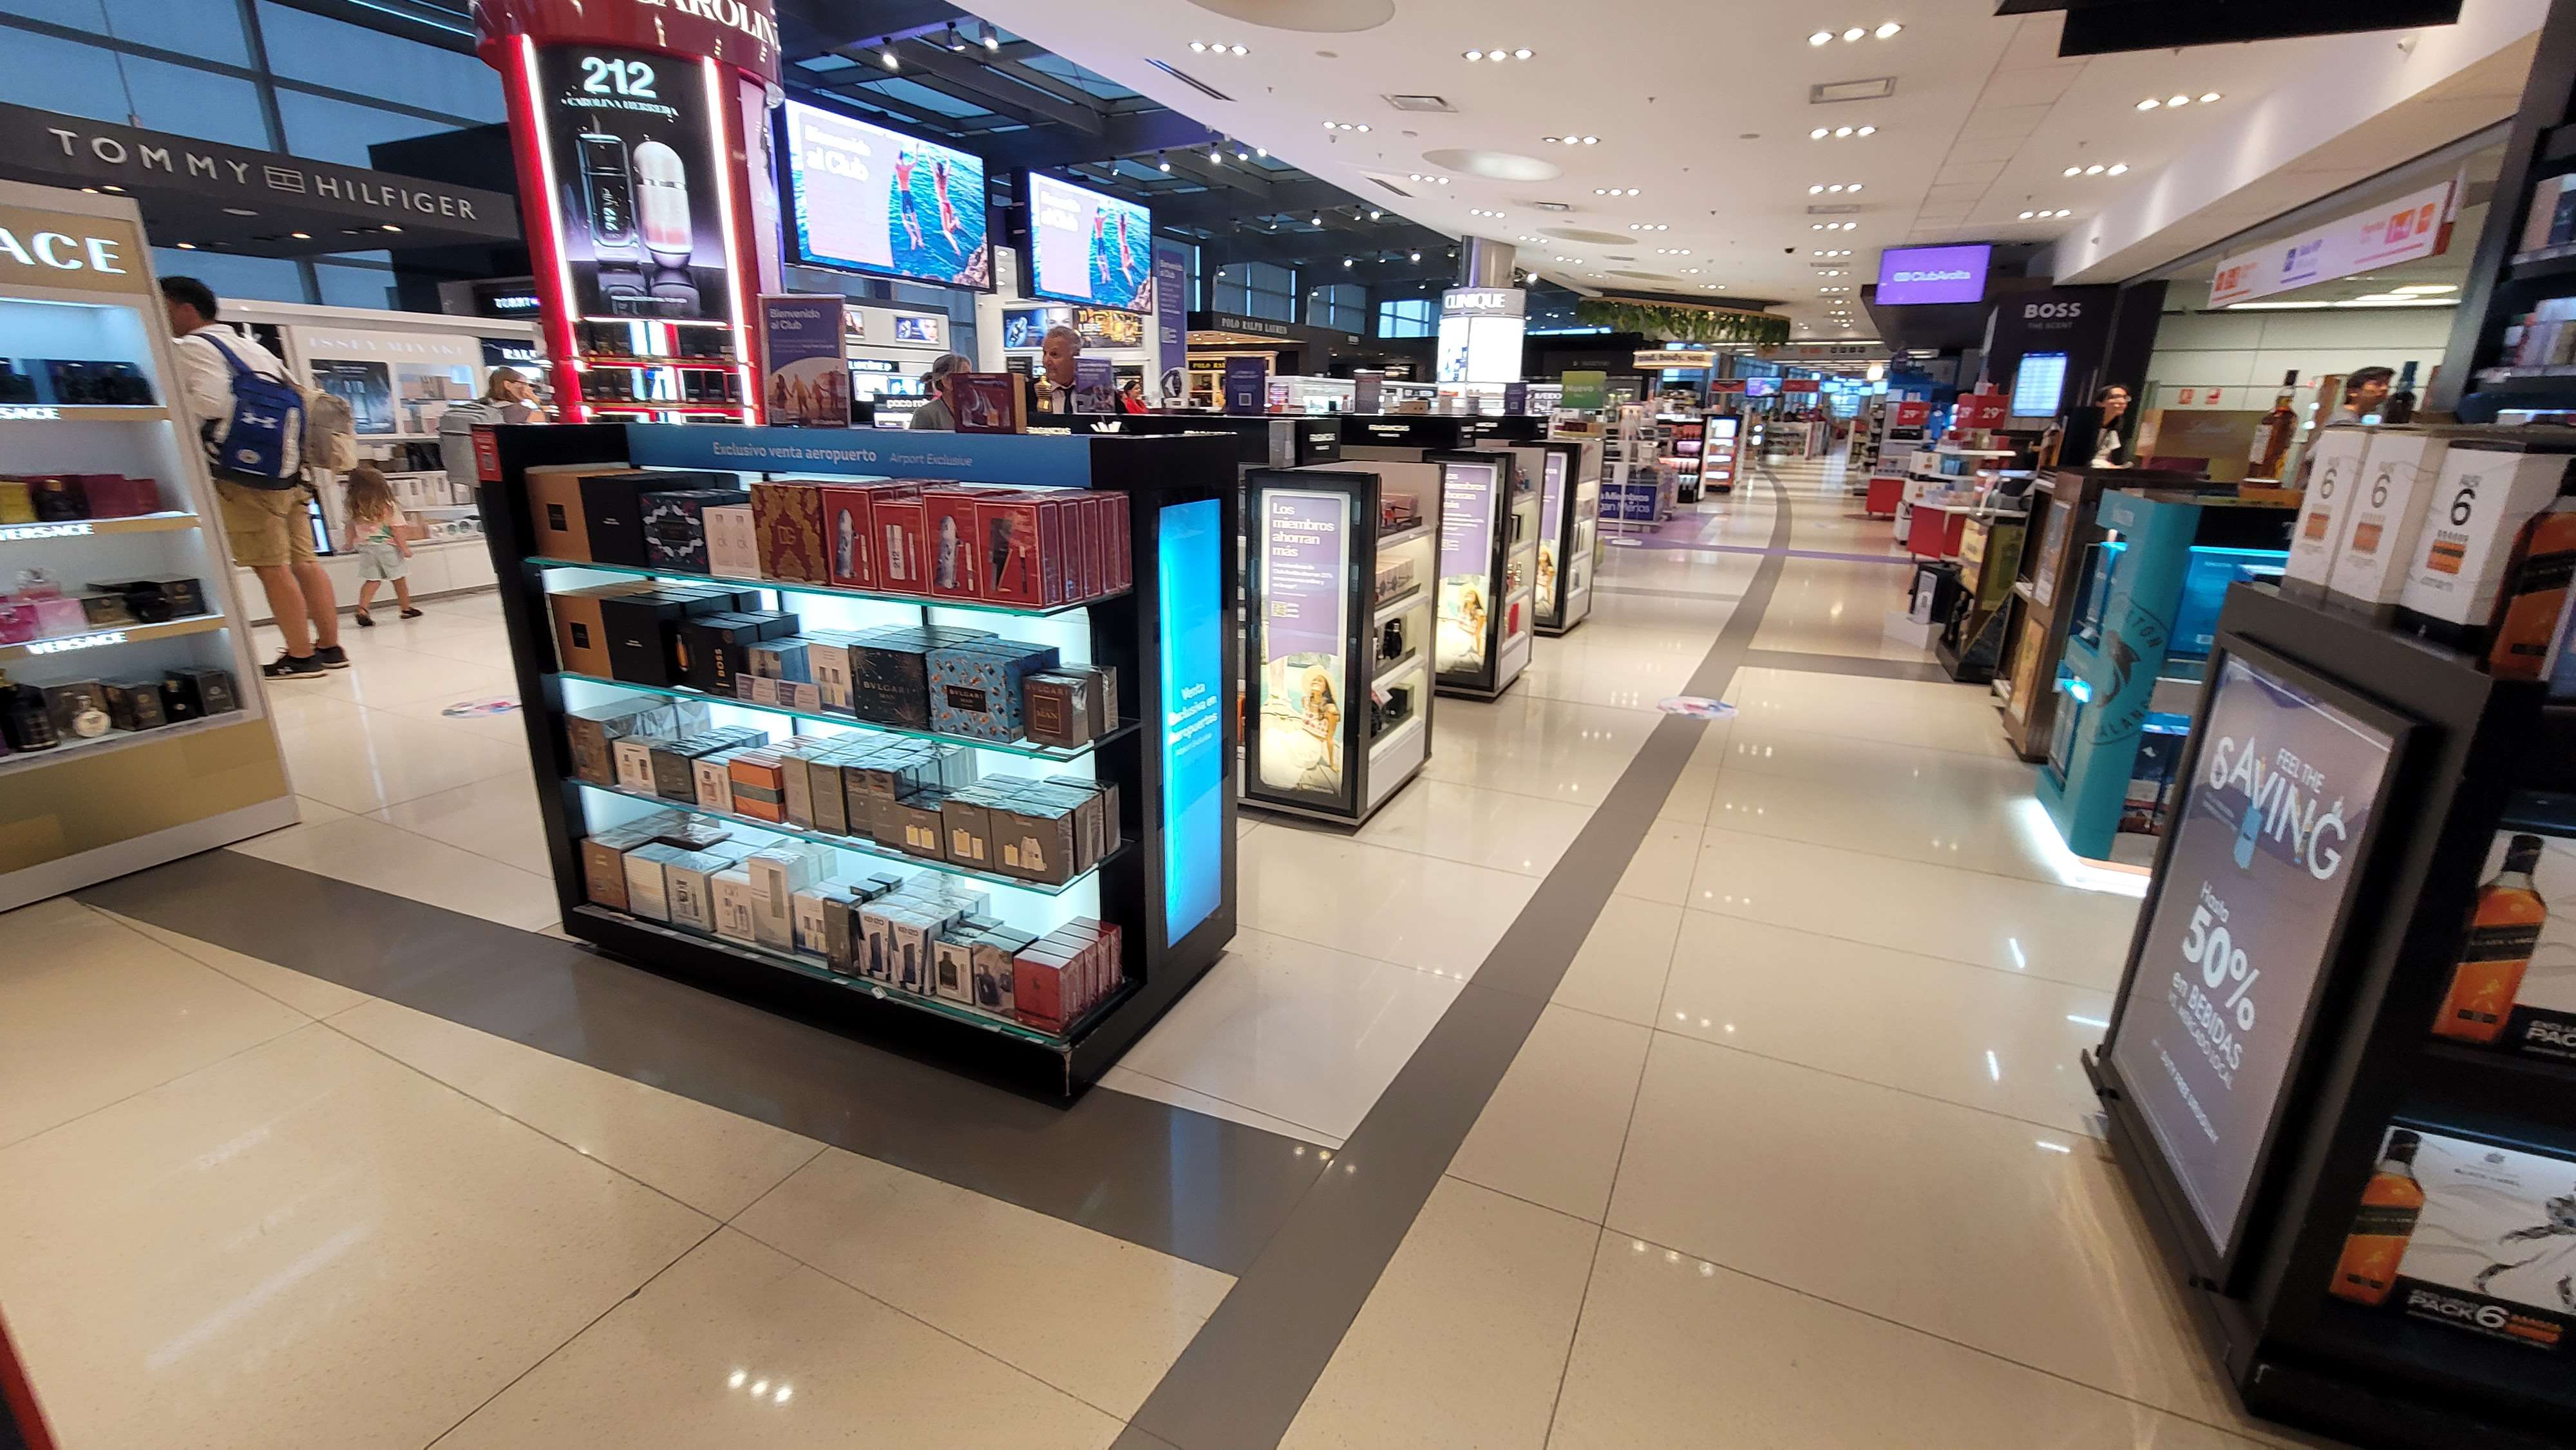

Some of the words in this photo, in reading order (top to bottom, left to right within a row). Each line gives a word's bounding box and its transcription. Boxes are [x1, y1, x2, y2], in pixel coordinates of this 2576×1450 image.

[582, 57, 657, 99] 212
[47, 127, 250, 185] TOMMY
[315, 174, 478, 221] HILFIGER
[825, 149, 869, 182] Club
[0, 229, 128, 274] ACE
[1444, 294, 1506, 310] CLINIQUE
[2023, 303, 2081, 318] BOSS
[712, 442, 767, 458] Exclusivo
[769, 446, 803, 459] venta
[805, 447, 877, 465] aeropuerto
[889, 453, 925, 466] Airport
[926, 453, 973, 467] Exclusive
[2320, 467, 2338, 500] 6
[2371, 474, 2391, 508] 6
[1273, 502, 1295, 515] Los
[2450, 488, 2476, 526] 6
[1272, 531, 1320, 545] ahorran
[1273, 517, 1335, 532] miembros
[1273, 545, 1299, 558] más
[26, 632, 128, 655] VERSACE
[863, 680, 911, 695] BVLGARI
[949, 688, 984, 701] BVLGARI
[1025, 683, 1069, 697] BVLGARI
[1036, 708, 1059, 720] MAN
[2276, 747, 2301, 779] FEEL
[2301, 762, 2326, 795] THE
[2210, 736, 2347, 880] SAVING
[2200, 880, 2230, 923] Hasta
[2182, 904, 2260, 1031] 50%
[2172, 972, 2188, 997] en
[2188, 984, 2243, 1070] BEBIDAS
[2406, 1293, 2474, 1322] PACK
[2476, 1304, 2510, 1330] 6
